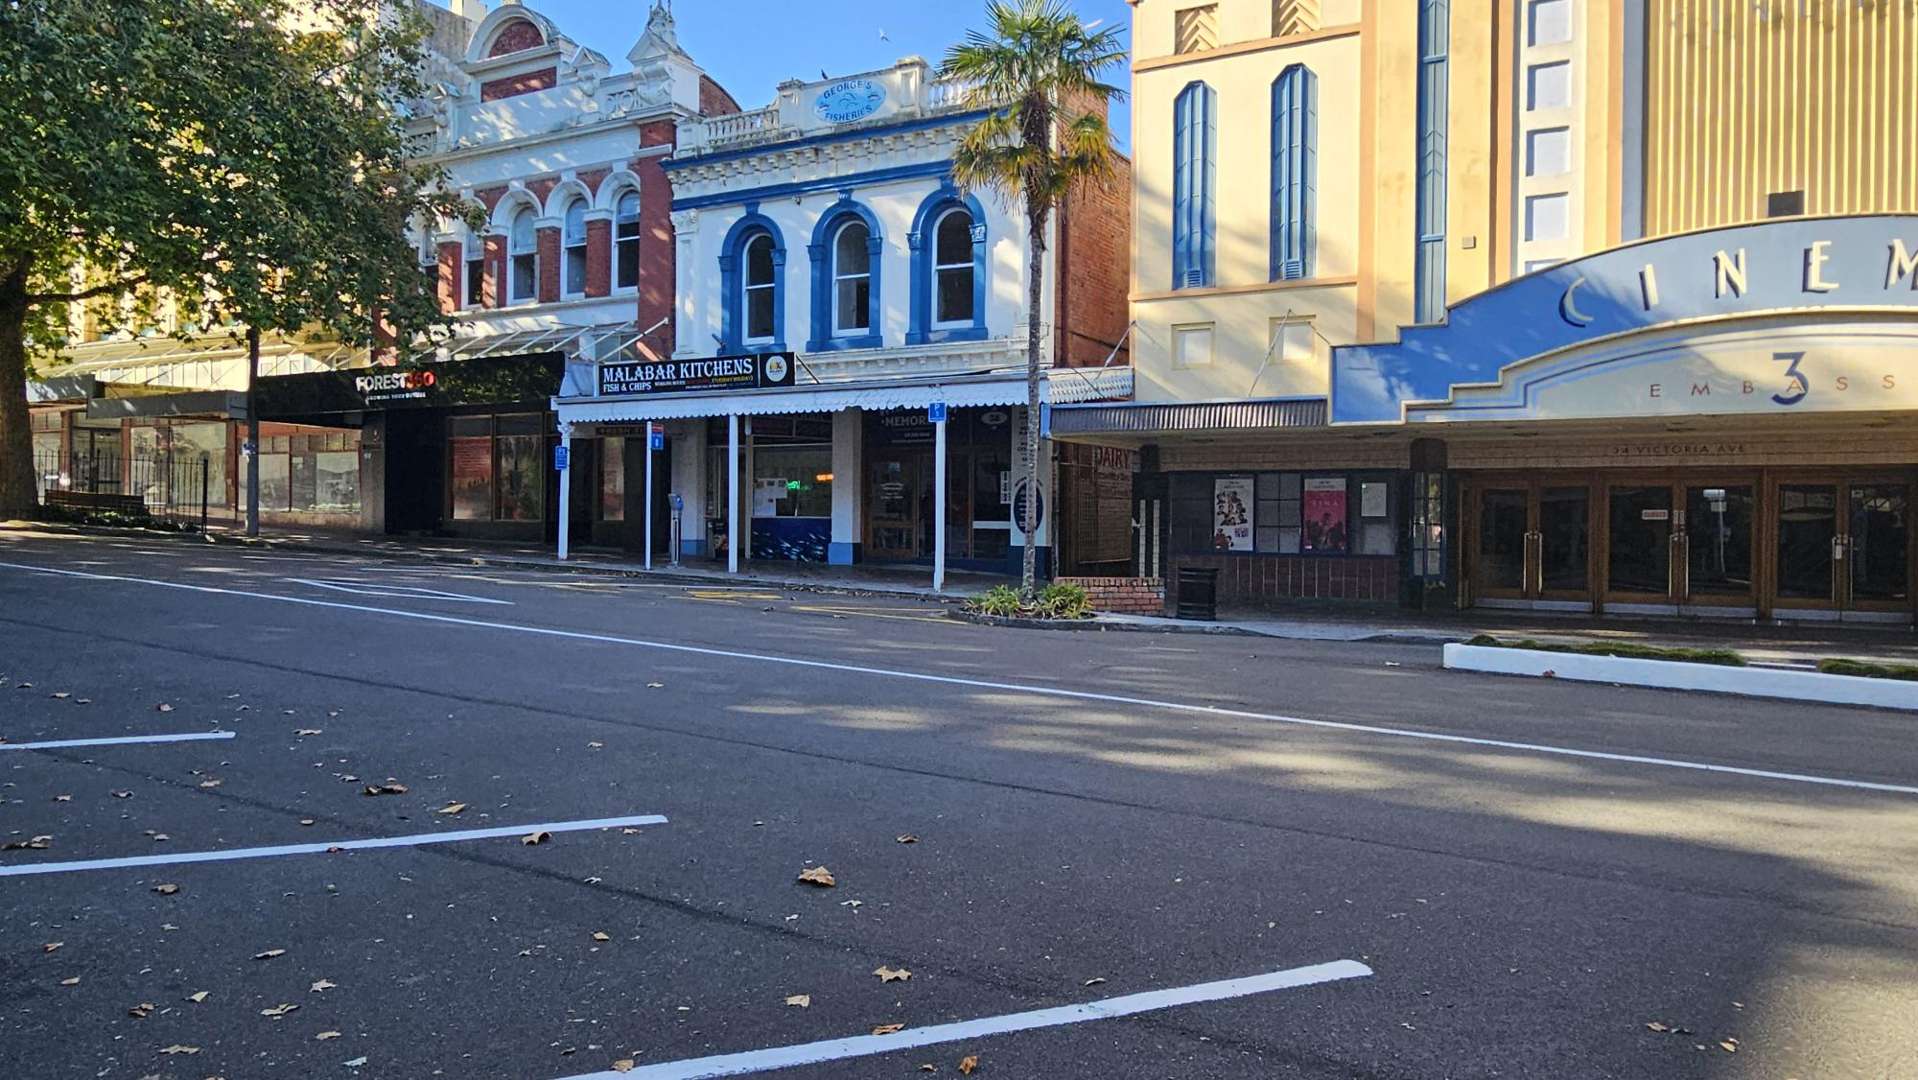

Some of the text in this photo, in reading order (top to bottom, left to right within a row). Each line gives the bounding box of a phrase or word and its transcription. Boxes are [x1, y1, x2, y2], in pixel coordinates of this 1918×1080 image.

[823, 80, 873, 99] GEORGE'S
[825, 104, 873, 121] FISHERIES
[603, 364, 676, 382] MALABAR
[680, 358, 753, 379] KITCHENS
[1772, 352, 1809, 405] 3
[603, 383, 620, 392] FISH
[621, 383, 628, 391] &
[629, 381, 652, 391] CHIPS
[1094, 446, 1129, 467] DAIRY
[1637, 444, 1709, 454] VICTORIA
